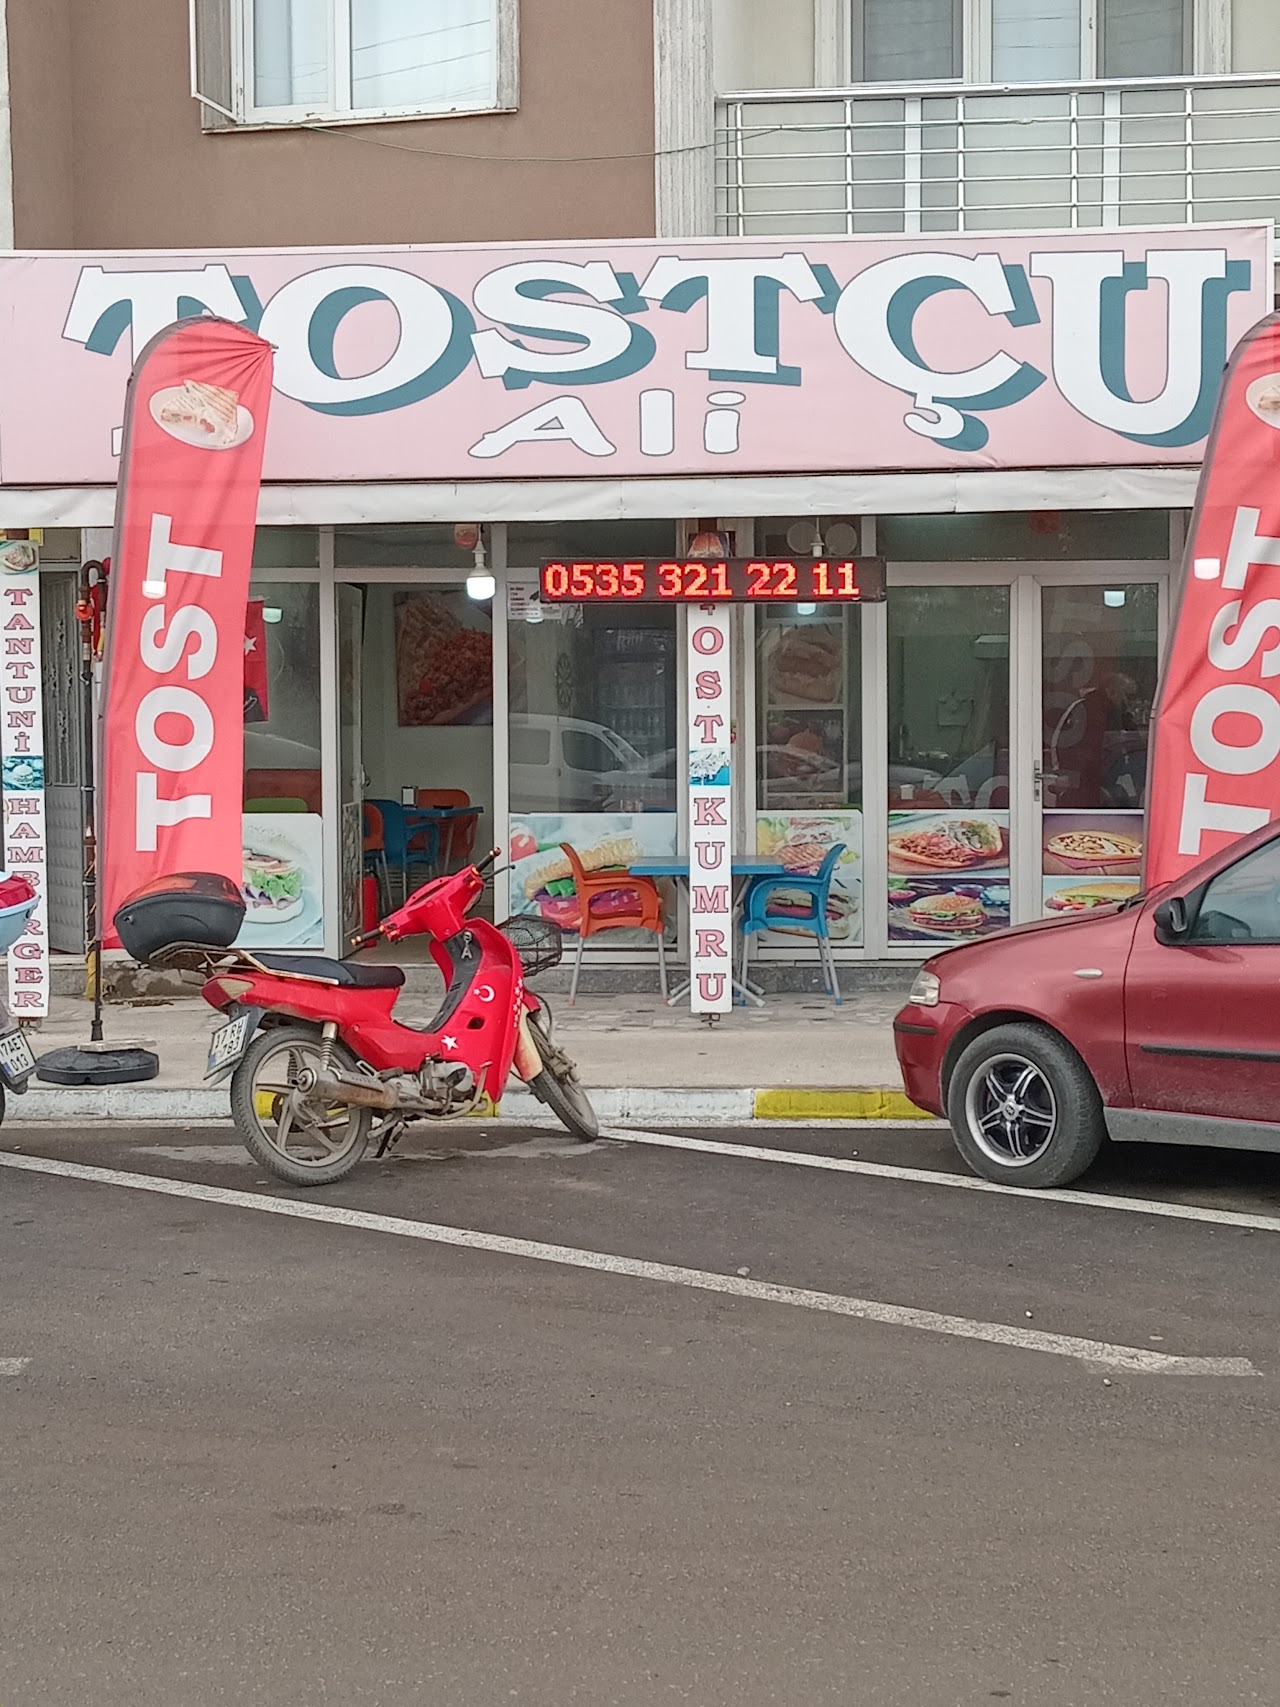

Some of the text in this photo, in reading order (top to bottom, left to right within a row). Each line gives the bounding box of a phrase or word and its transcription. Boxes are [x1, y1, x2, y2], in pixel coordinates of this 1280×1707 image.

[62, 249, 1248, 457] TOSTÇU
[467, 389, 746, 457] Ali
[2, 587, 37, 753] TANTUNİ
[545, 561, 859, 597] 0535 321 22 11
[136, 513, 223, 852] TOST
[691, 604, 726, 745] OST
[1178, 505, 1280, 856] TOST
[7, 797, 44, 1009] HAMBRGER
[693, 796, 729, 1002] KUMRU
[10, 1054, 29, 1071] 013
